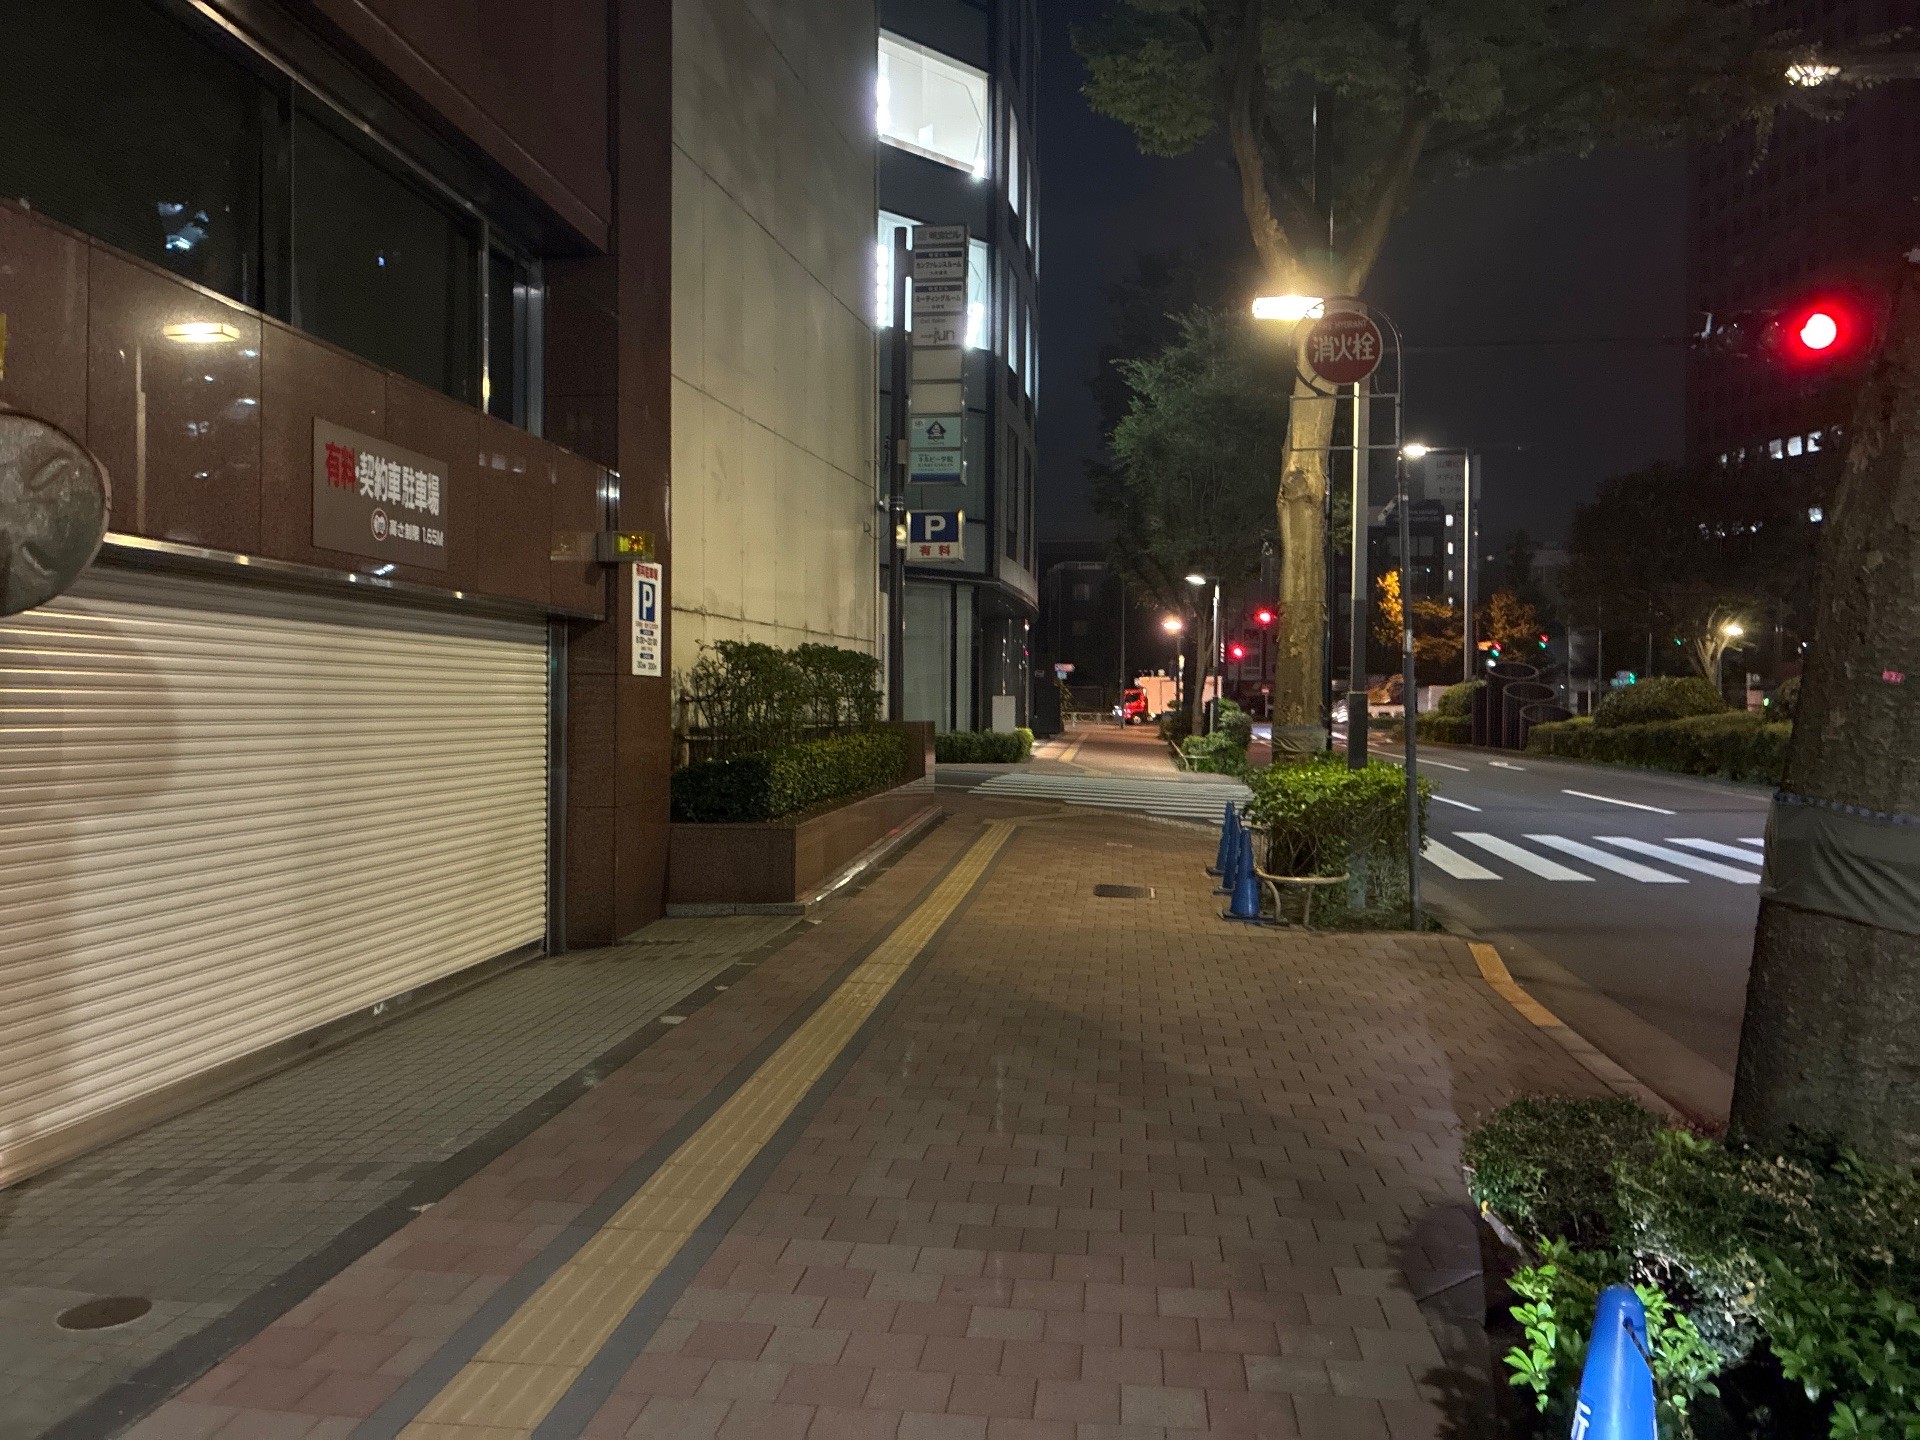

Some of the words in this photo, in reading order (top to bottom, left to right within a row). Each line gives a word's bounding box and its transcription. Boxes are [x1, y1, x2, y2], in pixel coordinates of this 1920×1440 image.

[1314, 332, 1375, 362] 消火栓
[924, 515, 946, 540] P
[920, 544, 951, 556] 有料
[642, 584, 653, 620] P
